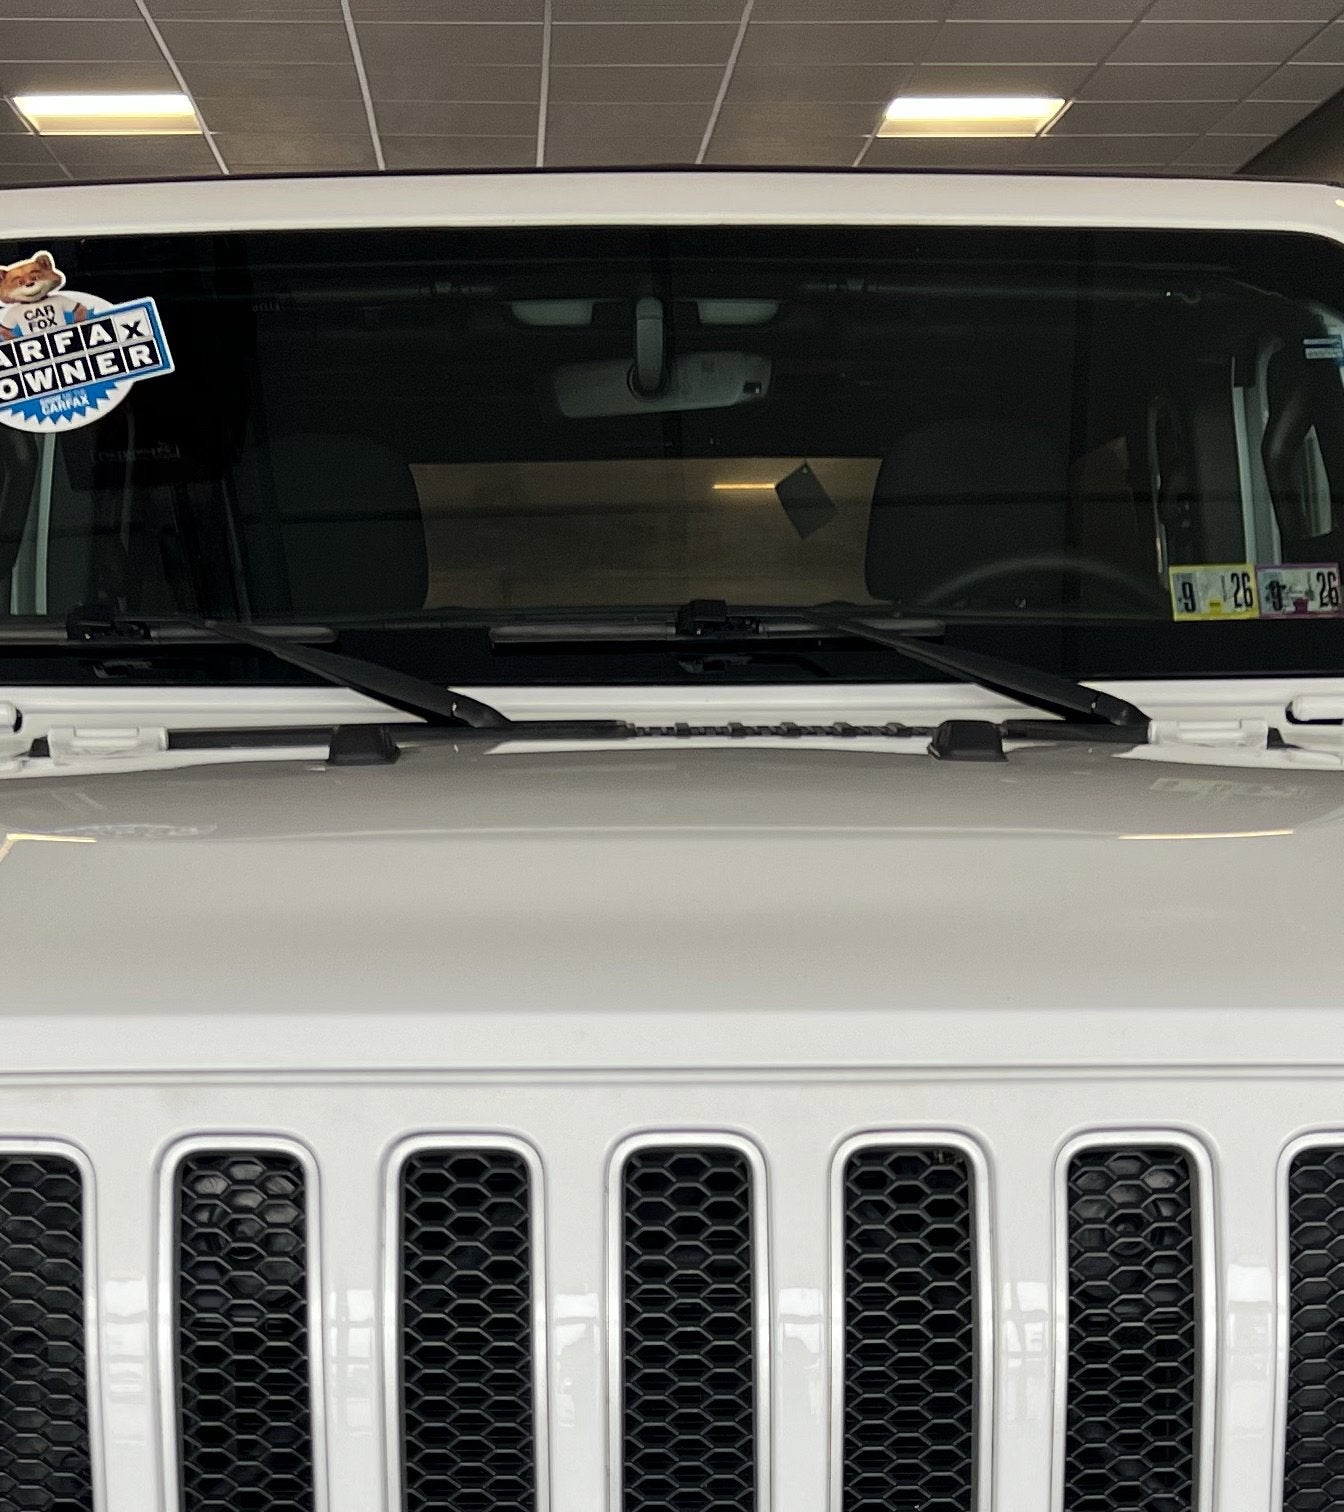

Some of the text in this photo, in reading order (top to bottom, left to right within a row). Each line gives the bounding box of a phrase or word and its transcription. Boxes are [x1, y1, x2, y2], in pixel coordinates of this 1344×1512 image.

[24, 304, 56, 321] CAR
[28, 317, 58, 332] FOX
[41, 396, 90, 416] CARFAX
[1181, 571, 1254, 613] 9 26
[1316, 571, 1340, 608] 26
